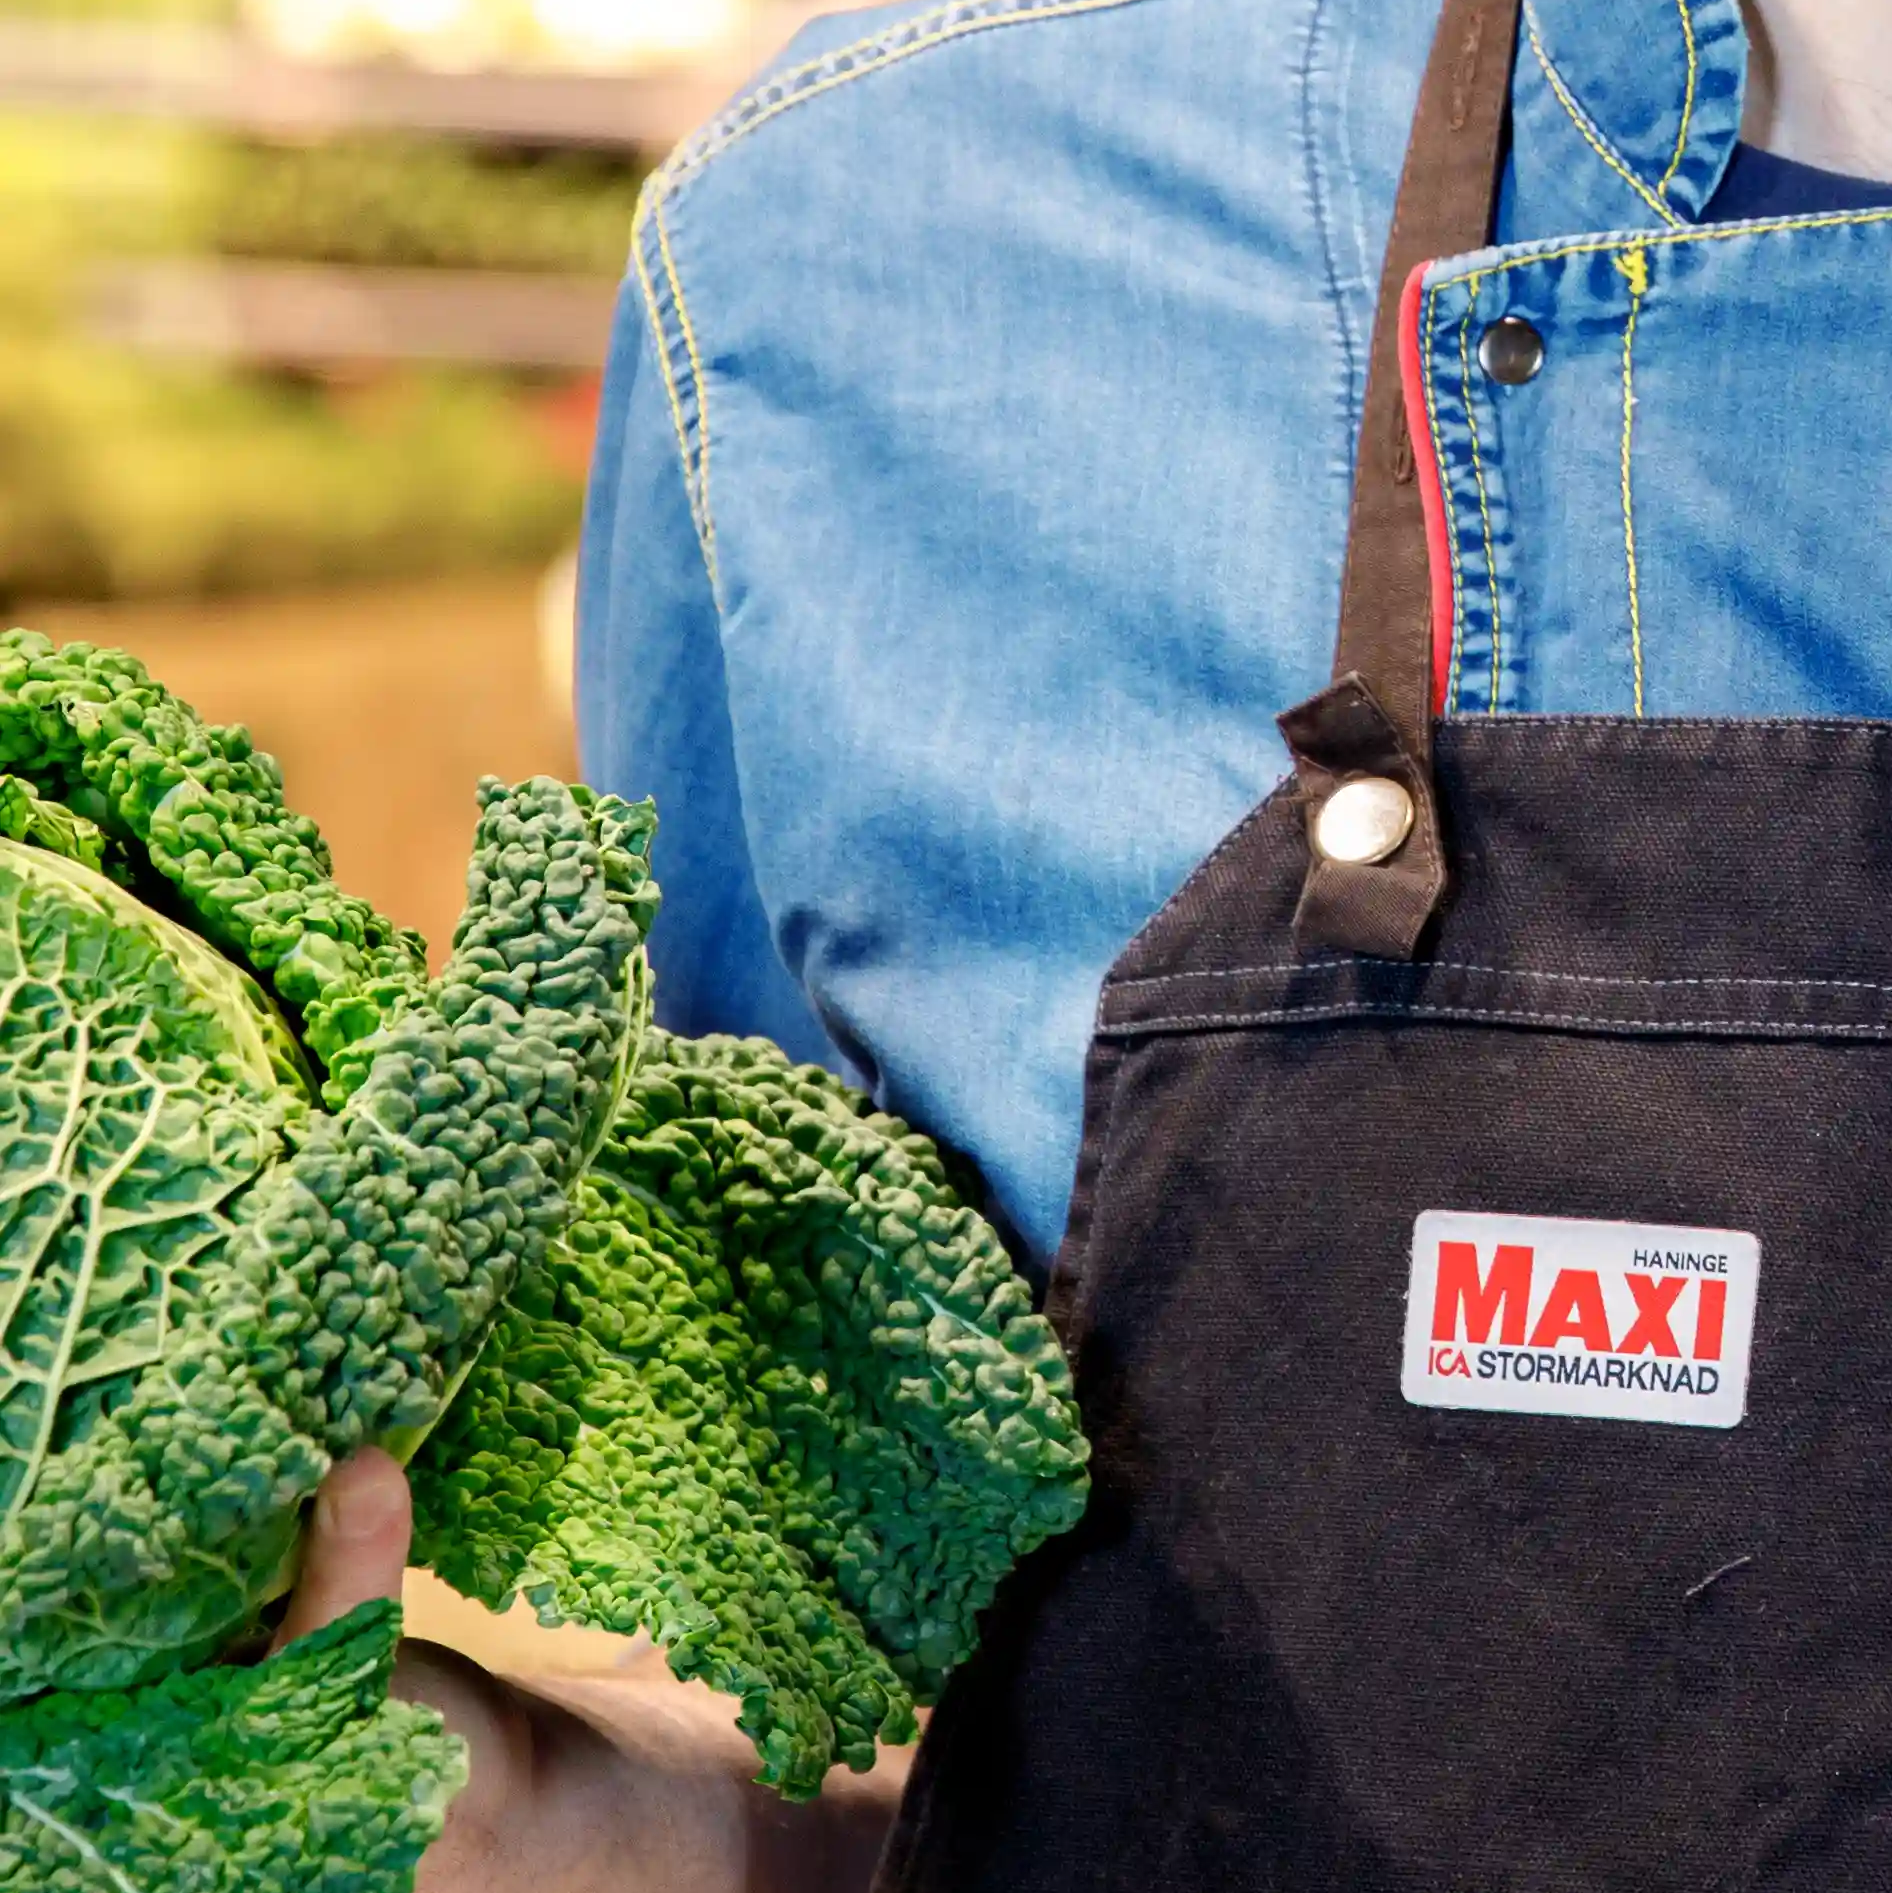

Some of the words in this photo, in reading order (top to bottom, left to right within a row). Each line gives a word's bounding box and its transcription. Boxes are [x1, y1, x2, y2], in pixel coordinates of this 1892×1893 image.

[1633, 1248, 1729, 1275] HANINGE
[1430, 1240, 1728, 1361] MAXI
[1427, 1345, 1472, 1379] ICA
[1476, 1351, 1720, 1396] STORMARKNAD
